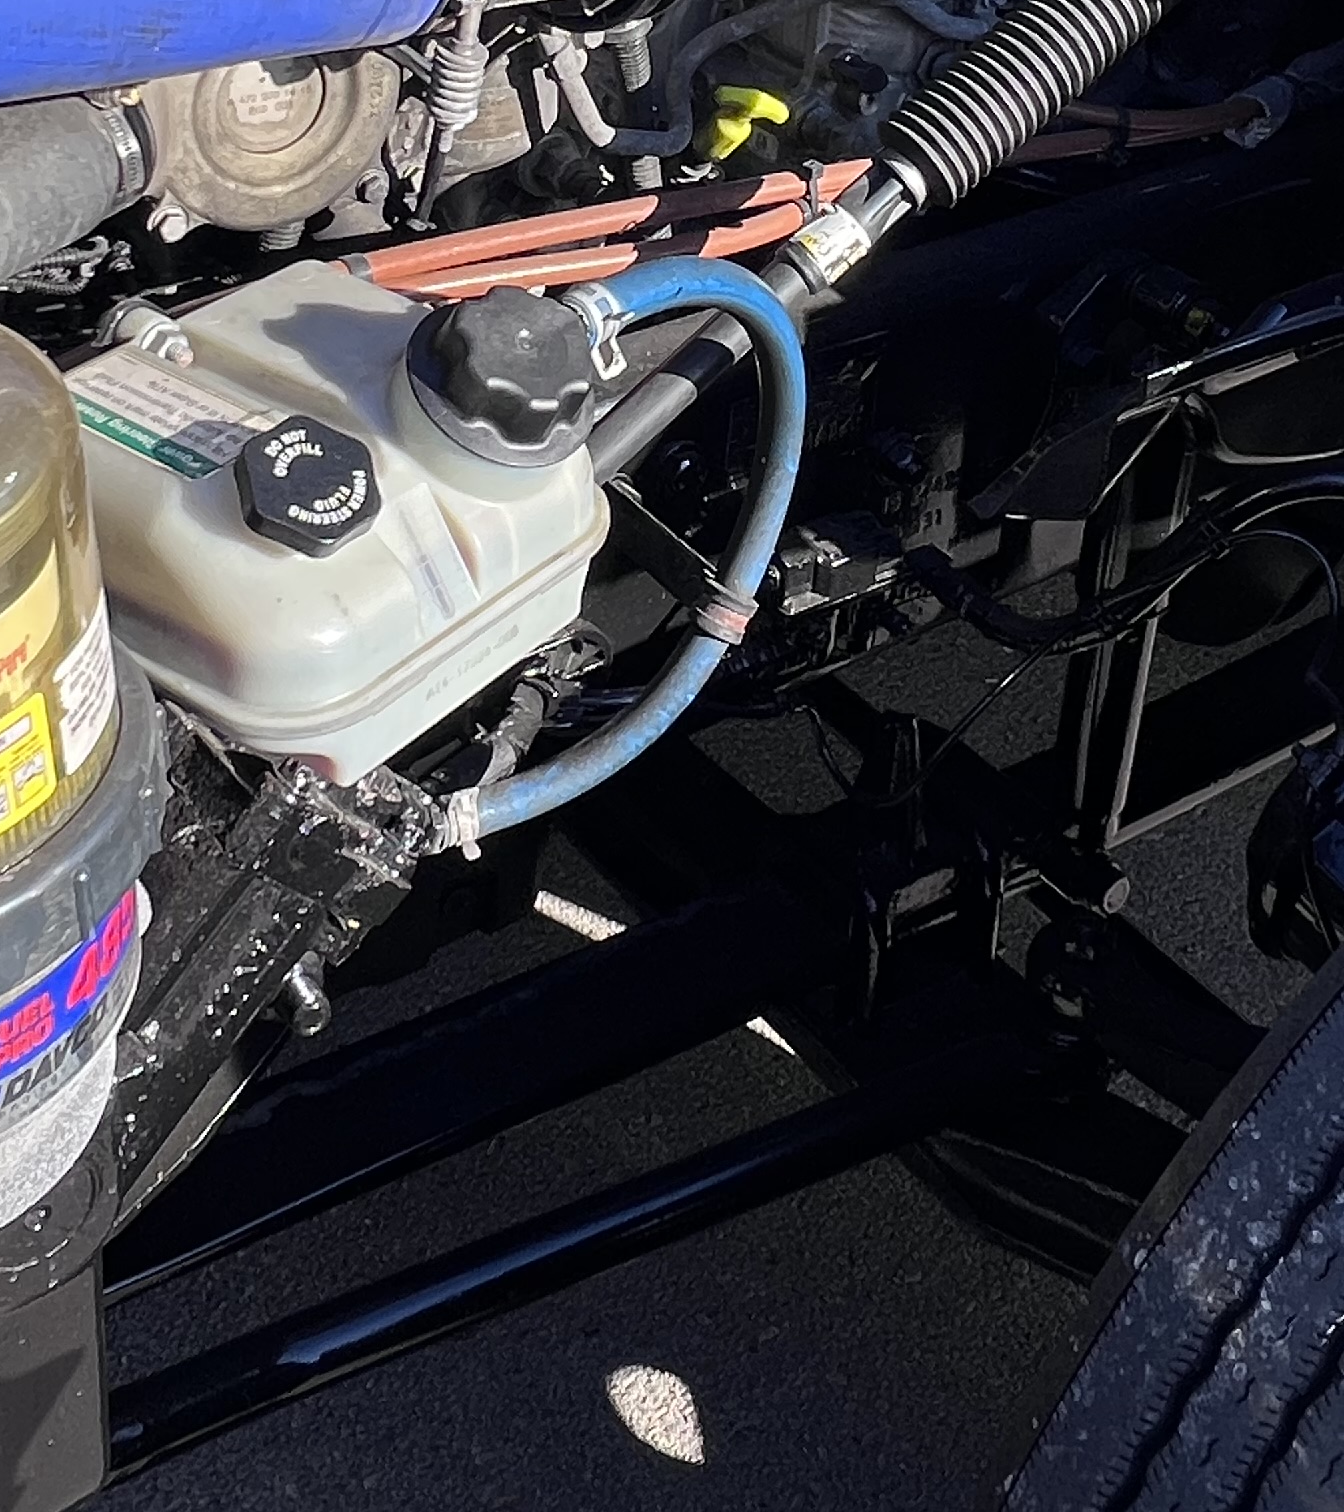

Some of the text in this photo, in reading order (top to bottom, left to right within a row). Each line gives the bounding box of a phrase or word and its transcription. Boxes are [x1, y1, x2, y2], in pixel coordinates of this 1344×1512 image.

[263, 428, 307, 458] DO NOT
[272, 442, 324, 478] OVERFILL
[287, 469, 367, 526] POWER STEERING
[313, 484, 352, 511] FLUID
